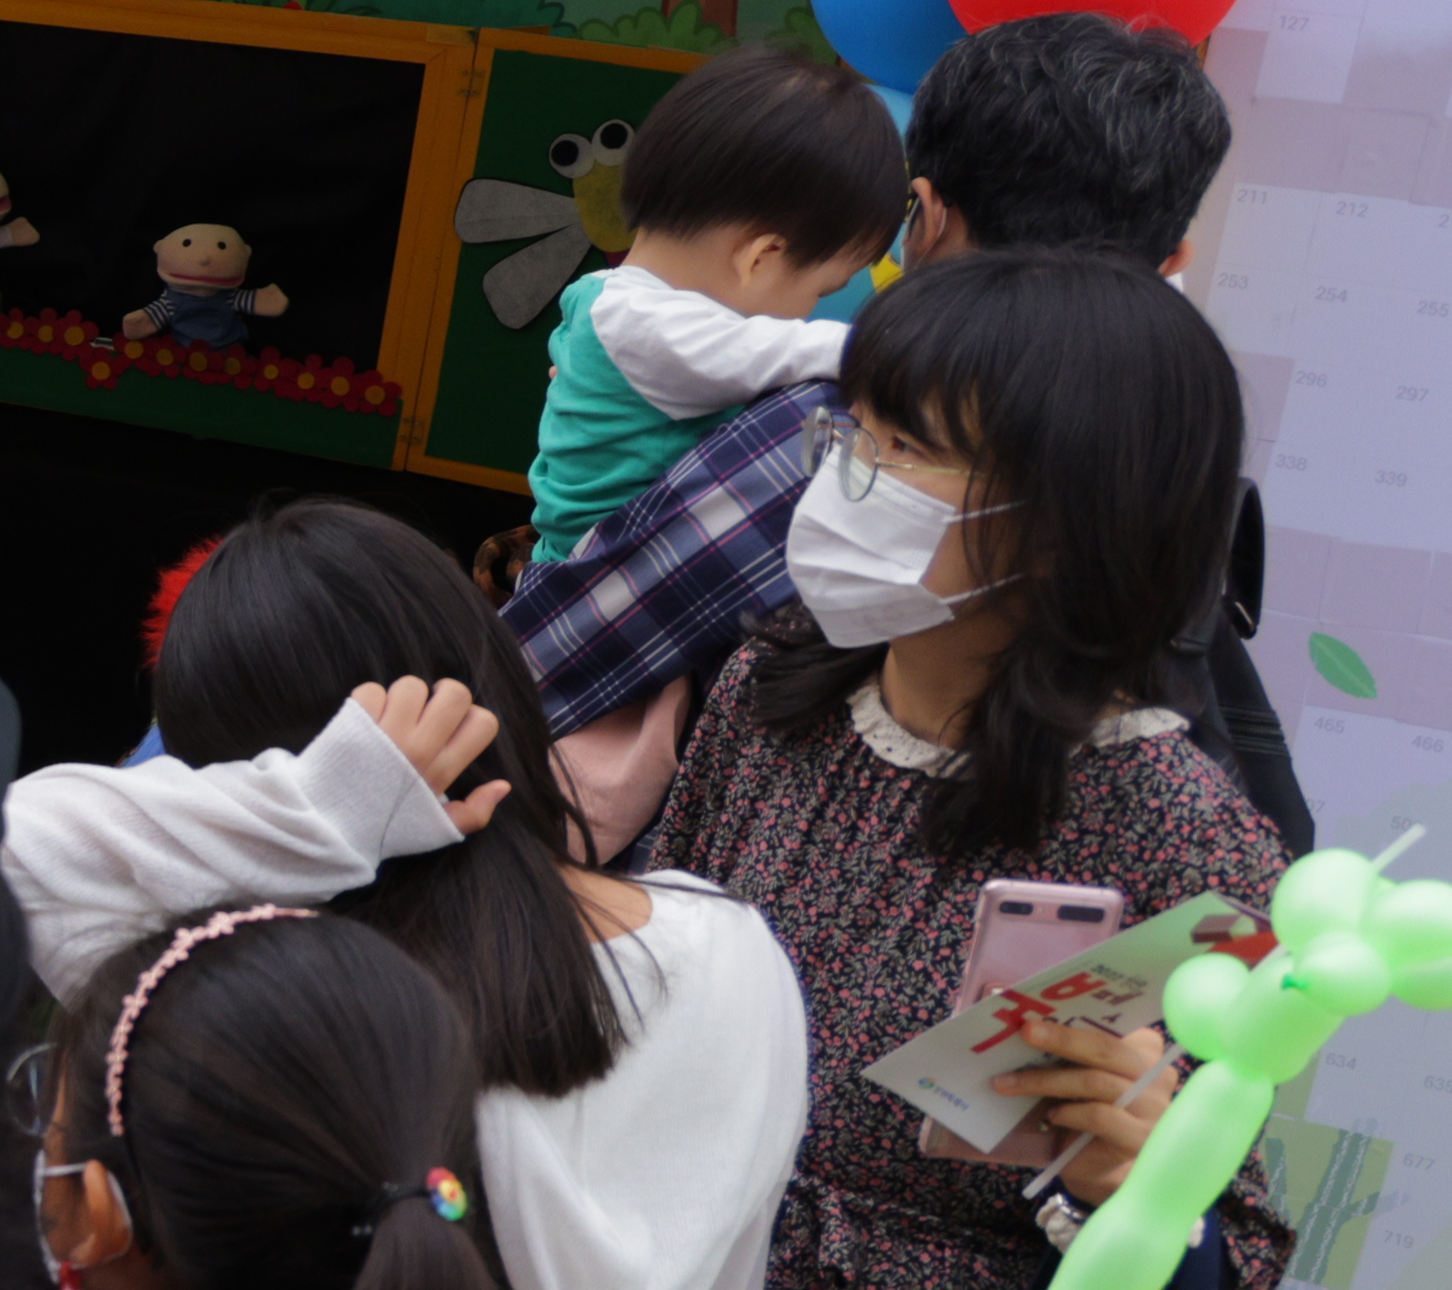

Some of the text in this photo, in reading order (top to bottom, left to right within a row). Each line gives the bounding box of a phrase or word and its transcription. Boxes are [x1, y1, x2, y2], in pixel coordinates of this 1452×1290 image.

[1278, 14, 1310, 32] 127
[1236, 188, 1269, 206] 211
[1335, 200, 1370, 219] 212
[1217, 272, 1249, 291] 253
[1315, 285, 1348, 304] 254
[1417, 299, 1450, 318] 255
[1294, 370, 1328, 389] 296
[1396, 385, 1430, 404] 297
[1275, 453, 1309, 472] 338
[1374, 469, 1408, 488] 339
[1314, 716, 1346, 735] 465
[1410, 734, 1445, 753] 466
[1325, 1051, 1357, 1072] 634
[1401, 1152, 1435, 1173] 677
[1382, 1229, 1415, 1250] 719
